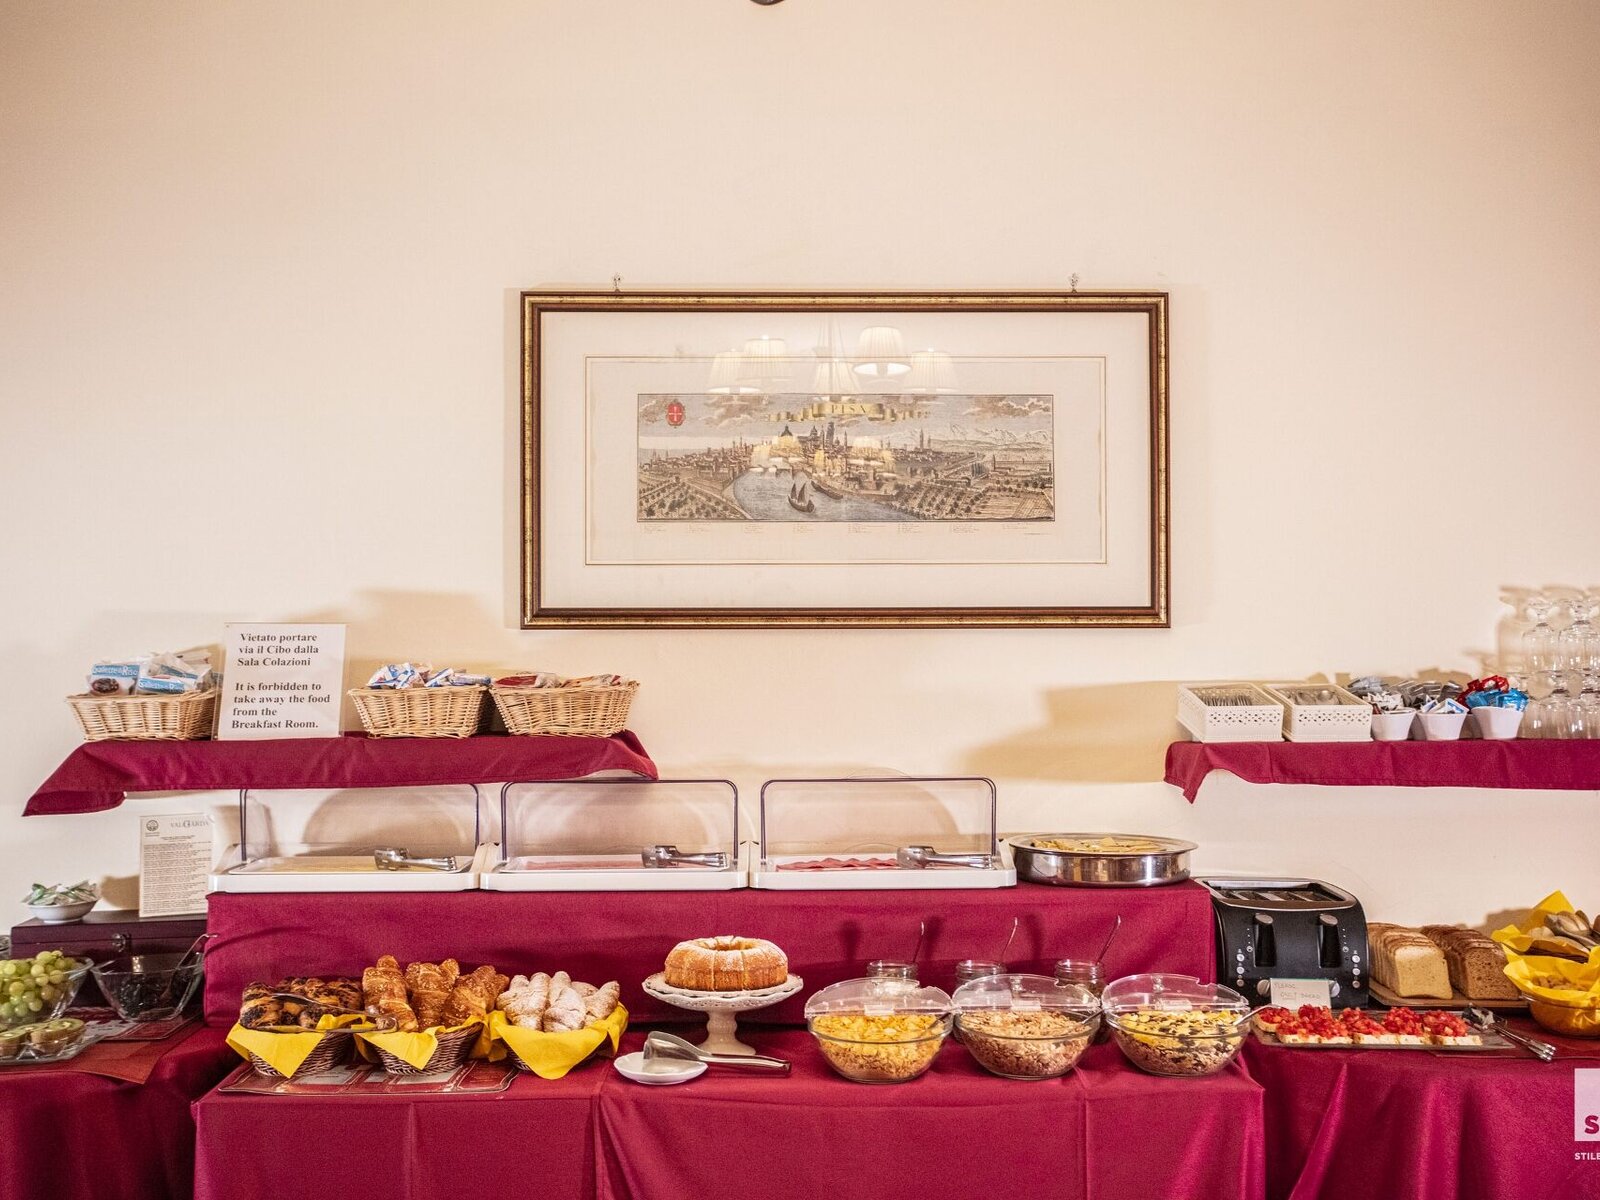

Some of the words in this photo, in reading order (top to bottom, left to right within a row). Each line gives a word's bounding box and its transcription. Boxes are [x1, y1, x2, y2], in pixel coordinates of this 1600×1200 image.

[240, 633, 277, 642] Vietato
[279, 634, 318, 644] portare
[239, 646, 254, 654] via
[257, 645, 264, 654] il
[266, 645, 291, 654] Cibo
[293, 645, 319, 654] dalla
[237, 657, 260, 666] Sala
[262, 657, 311, 666] Colazioni
[235, 682, 244, 691] It
[246, 682, 255, 691] is
[258, 682, 308, 691] forbidden
[311, 683, 322, 691] to
[233, 695, 256, 703] take
[258, 696, 285, 705] away
[288, 695, 305, 703] the
[308, 694, 331, 703] food
[232, 707, 258, 716] from
[261, 707, 277, 716] the
[231, 720, 281, 729] Breakfast
[285, 720, 319, 729] Room.
